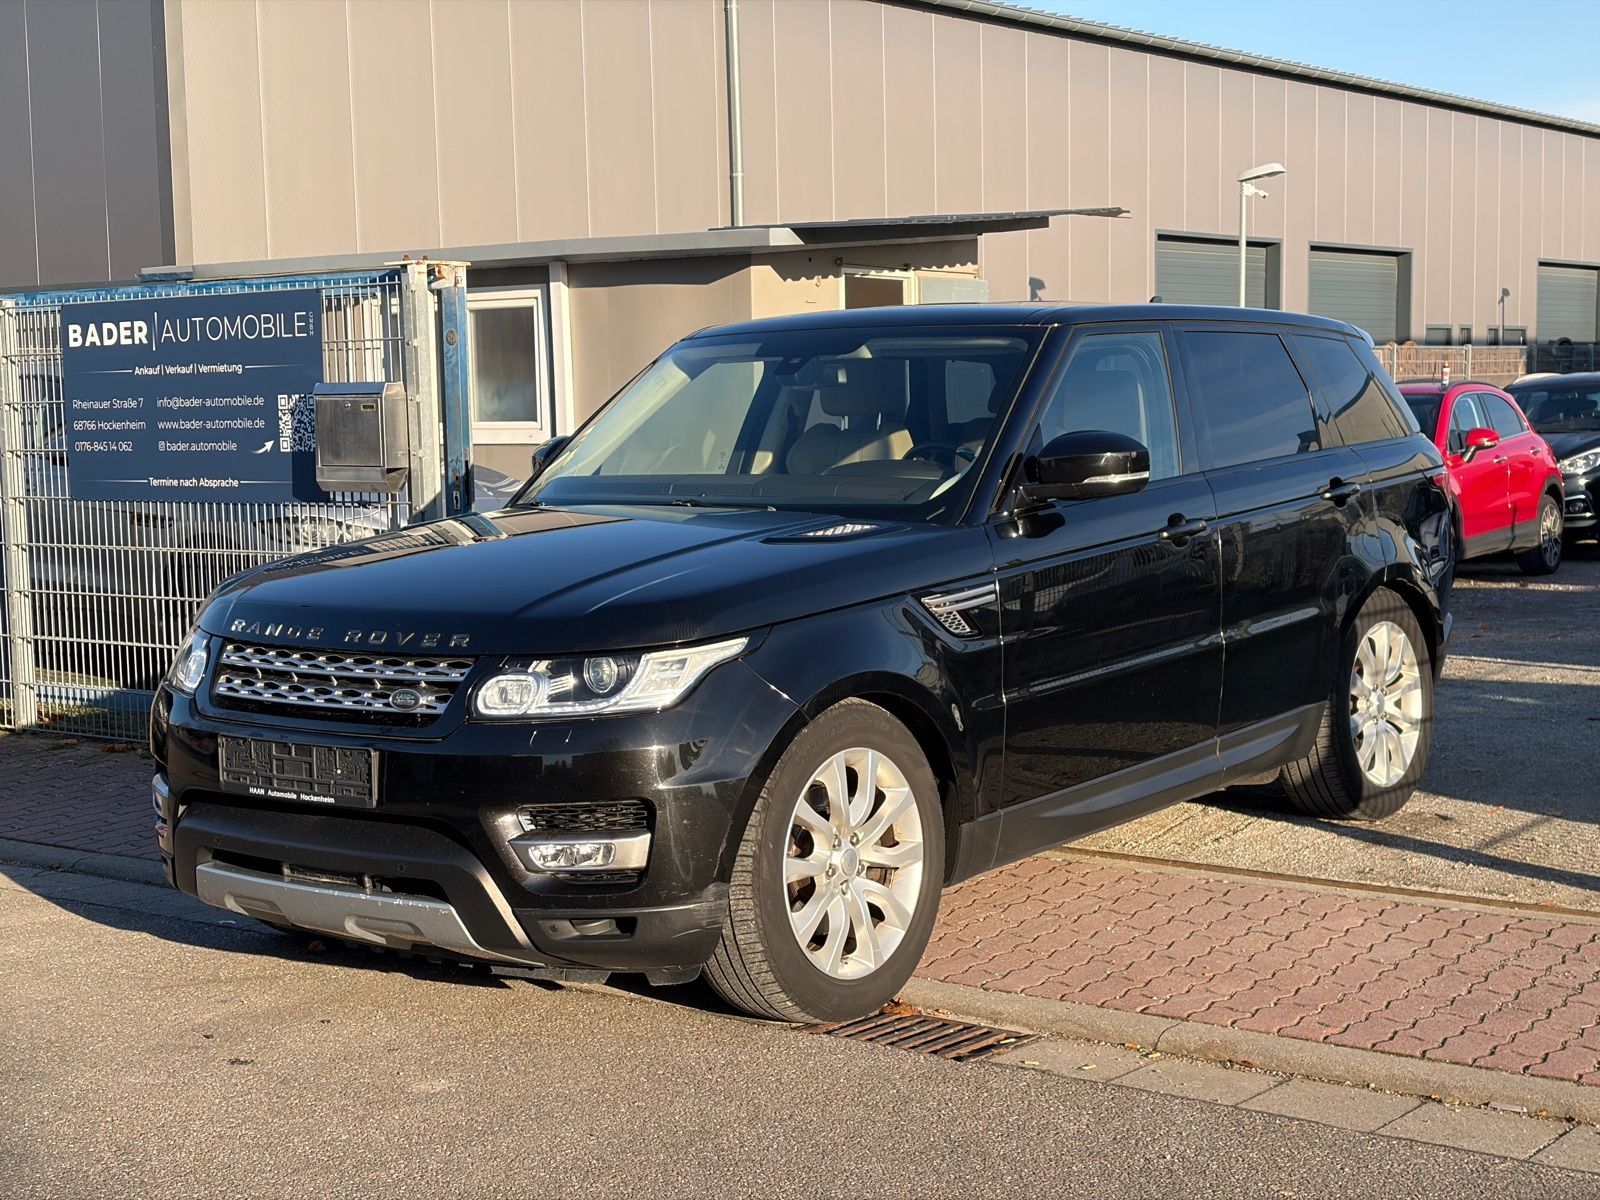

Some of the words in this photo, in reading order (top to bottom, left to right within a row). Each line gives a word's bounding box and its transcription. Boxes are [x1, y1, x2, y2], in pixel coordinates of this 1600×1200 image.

[68, 320, 148, 347] BADER
[161, 312, 307, 344] AUTOMOBILE
[134, 365, 160, 375] Ankauf
[165, 363, 193, 374] Verkauf
[198, 362, 243, 374] Vermietung
[72, 399, 111, 409] Rheinauer
[112, 397, 137, 408] Straße
[138, 397, 144, 408] 7
[156, 395, 265, 409] info@bader-automobile.de
[73, 420, 96, 431] 68766
[97, 419, 147, 430] Hockenheim
[157, 417, 265, 429] www.bader-automobile.de
[148, 476, 178, 487] Termine
[179, 476, 198, 487] nach
[199, 477, 239, 489] Absprache
[230, 618, 324, 640] RANGE
[344, 629, 471, 648] ROVER
[249, 786, 265, 795] HAAN
[267, 789, 298, 800] Automobile
[300, 793, 335, 803] Hockenheim
